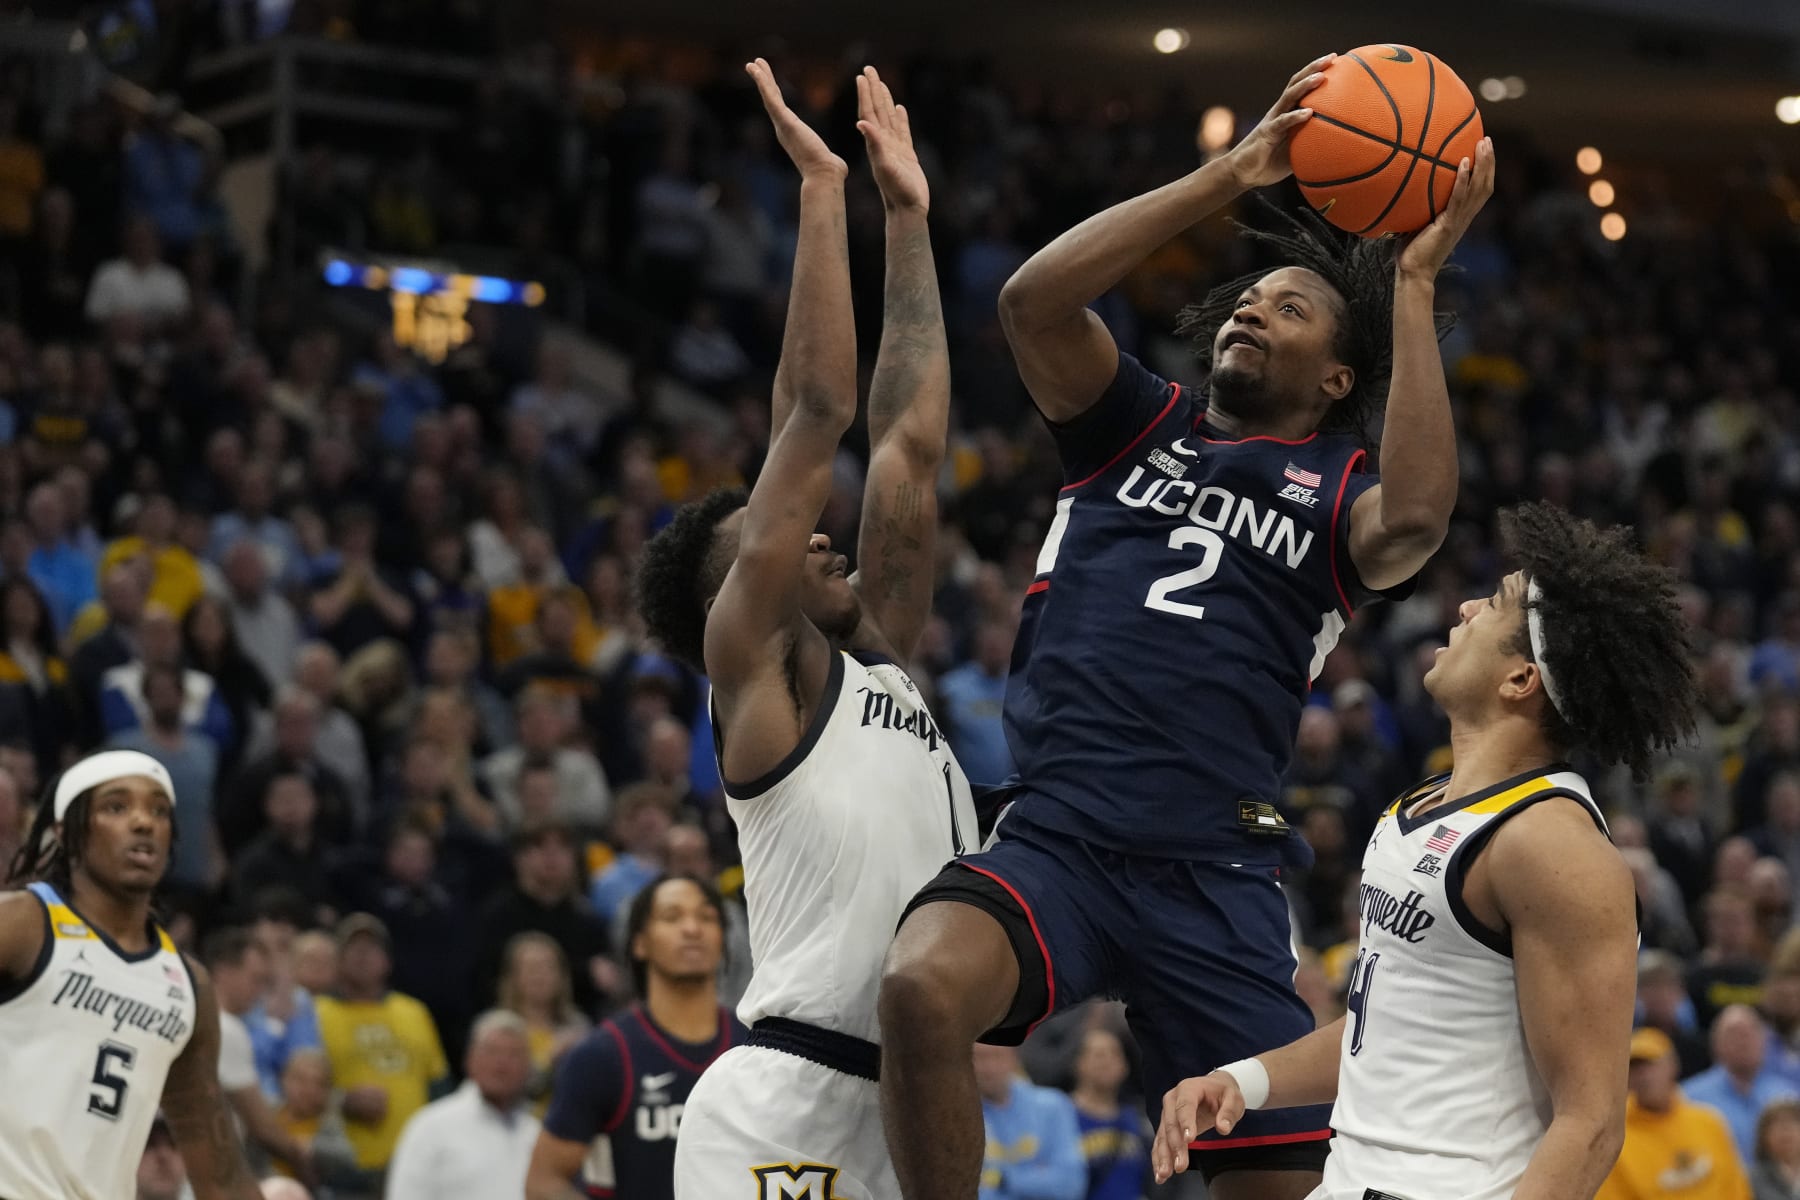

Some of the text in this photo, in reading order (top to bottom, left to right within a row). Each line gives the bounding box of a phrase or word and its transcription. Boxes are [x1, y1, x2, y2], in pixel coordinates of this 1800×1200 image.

[1116, 464, 1315, 570] UCONN
[1281, 487, 1320, 505] EAST
[1285, 482, 1316, 496] BIG
[1144, 525, 1225, 620] 2
[1416, 861, 1442, 875] EAST
[1422, 853, 1442, 865] BIG
[1357, 879, 1436, 944] arquette
[52, 968, 189, 1045] Marquette
[87, 1038, 139, 1124] 5
